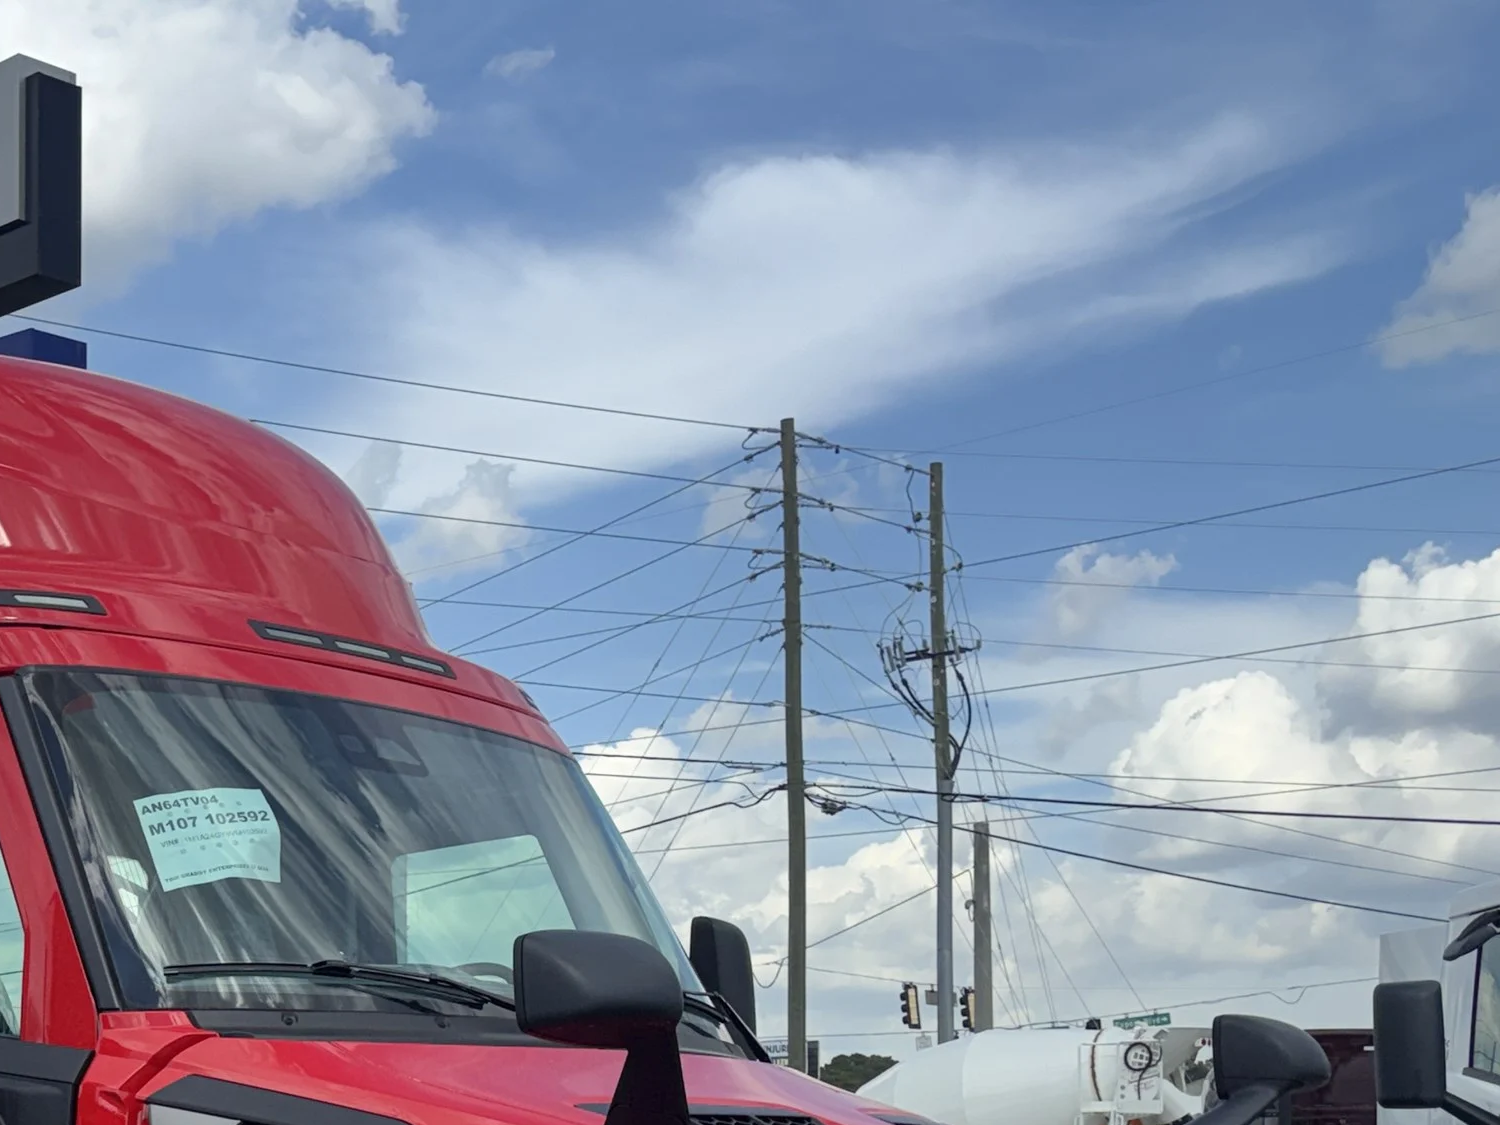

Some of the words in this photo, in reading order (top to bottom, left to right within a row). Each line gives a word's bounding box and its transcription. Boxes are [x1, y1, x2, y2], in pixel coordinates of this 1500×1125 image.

[141, 795, 219, 815] AN64TV04
[148, 816, 198, 836] M107
[205, 810, 270, 825] 102592
